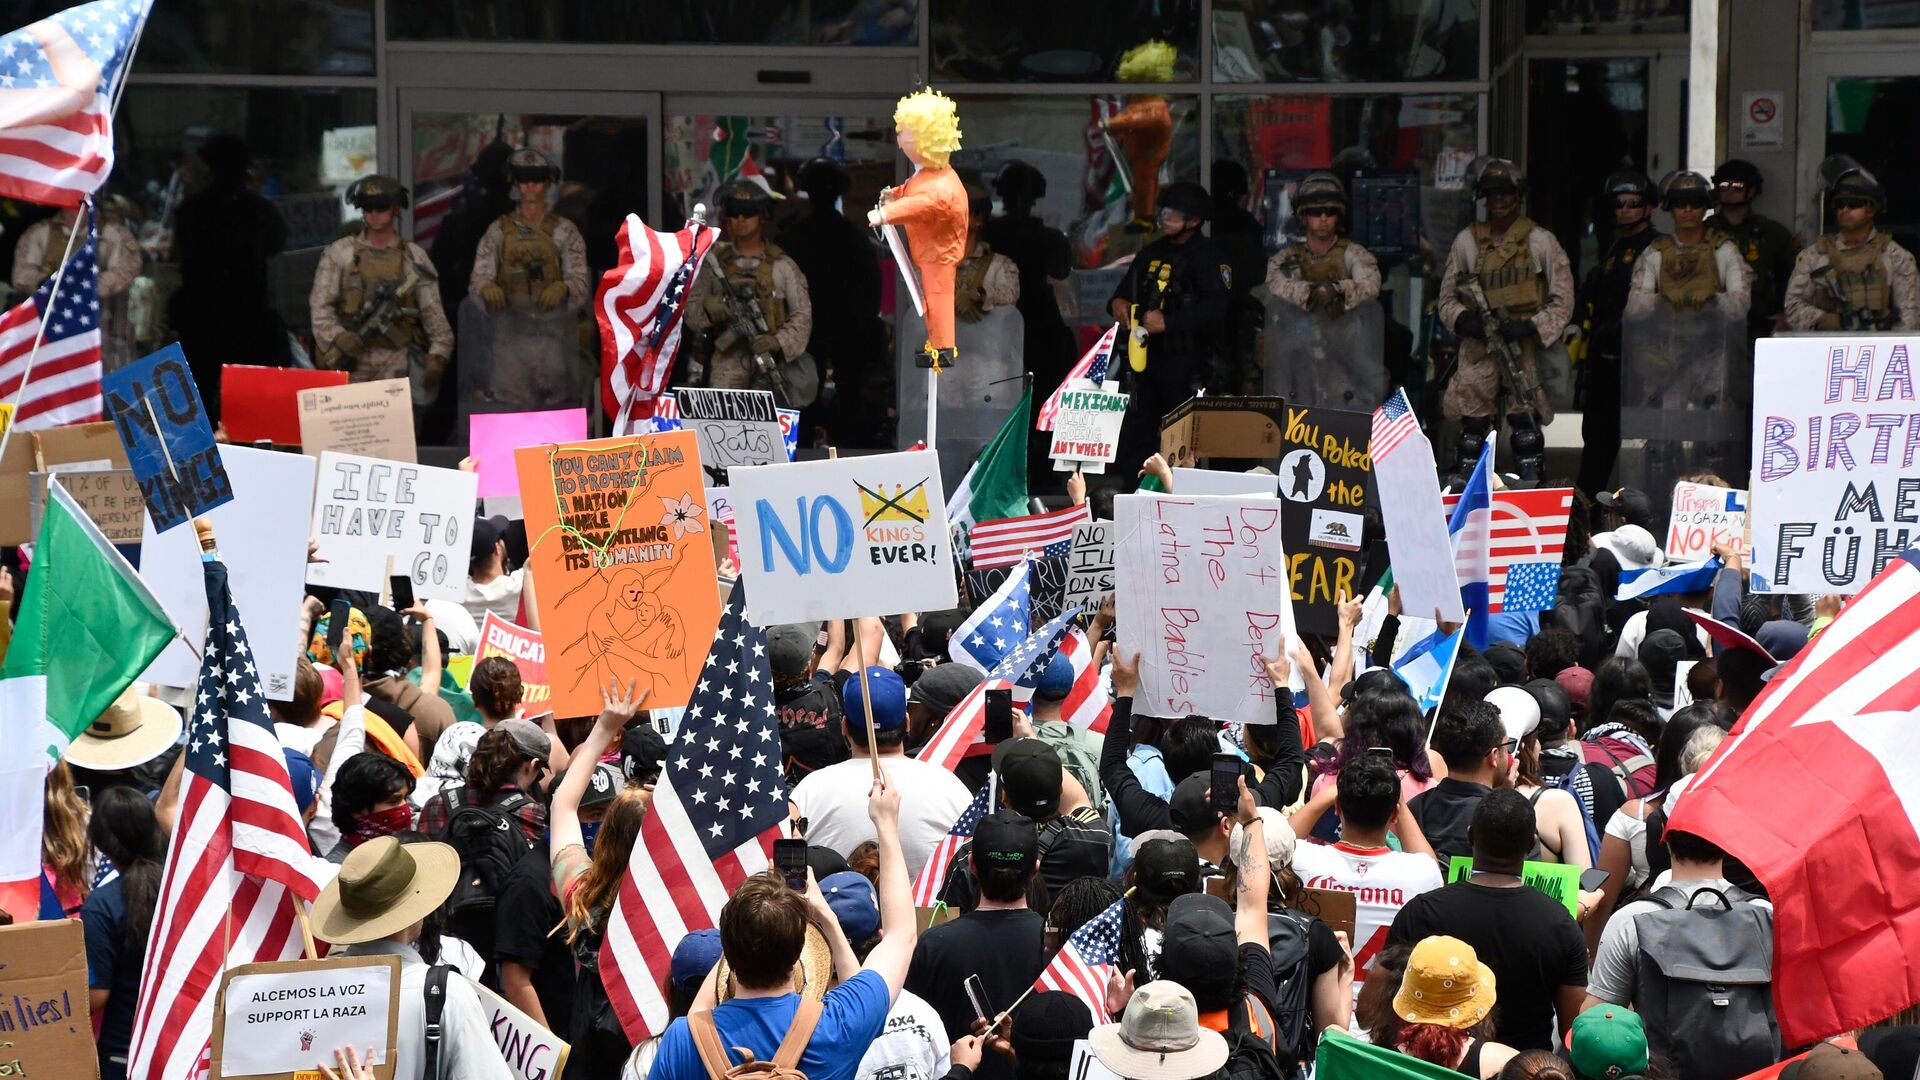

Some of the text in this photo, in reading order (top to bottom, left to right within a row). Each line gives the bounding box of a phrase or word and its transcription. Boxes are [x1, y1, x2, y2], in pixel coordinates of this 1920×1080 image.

[1824, 344, 1916, 404] HA
[107, 359, 199, 448] NO
[677, 389, 773, 421] CRUSH FASCIST
[1060, 391, 1130, 412] MEXICANS
[1284, 407, 1319, 448] You
[705, 424, 770, 463] Rats
[1052, 440, 1112, 458] ANYWHERE
[552, 457, 584, 477] YOU
[634, 446, 684, 468] CLAIM
[96, 476, 111, 491] OF
[137, 446, 234, 530] KINGS
[333, 462, 418, 504] ICE
[554, 469, 648, 495] TO PROTECT
[1327, 480, 1364, 507] the
[572, 490, 628, 512] NATION
[1677, 486, 1720, 512] From
[1834, 478, 1920, 523] ME
[321, 505, 459, 546] HAVE TO
[1693, 512, 1729, 524] GAZA
[755, 494, 855, 576] NO
[865, 525, 925, 543] KINGS
[1074, 526, 1105, 547] NO
[1239, 506, 1279, 585] Don't
[1670, 524, 1706, 556] NO
[565, 543, 674, 571] ITS HUMANITY
[869, 544, 937, 566] EVER!
[1201, 516, 1235, 590] The
[968, 569, 1007, 599] NO
[1069, 576, 1095, 592] ON
[1157, 500, 1205, 714] Latina Baddies
[252, 984, 366, 1003] ALCEMOS LA VOZ
[247, 1005, 367, 1024] SUPPORT LA RAZA
[888, 1014, 916, 1028] 4X4
